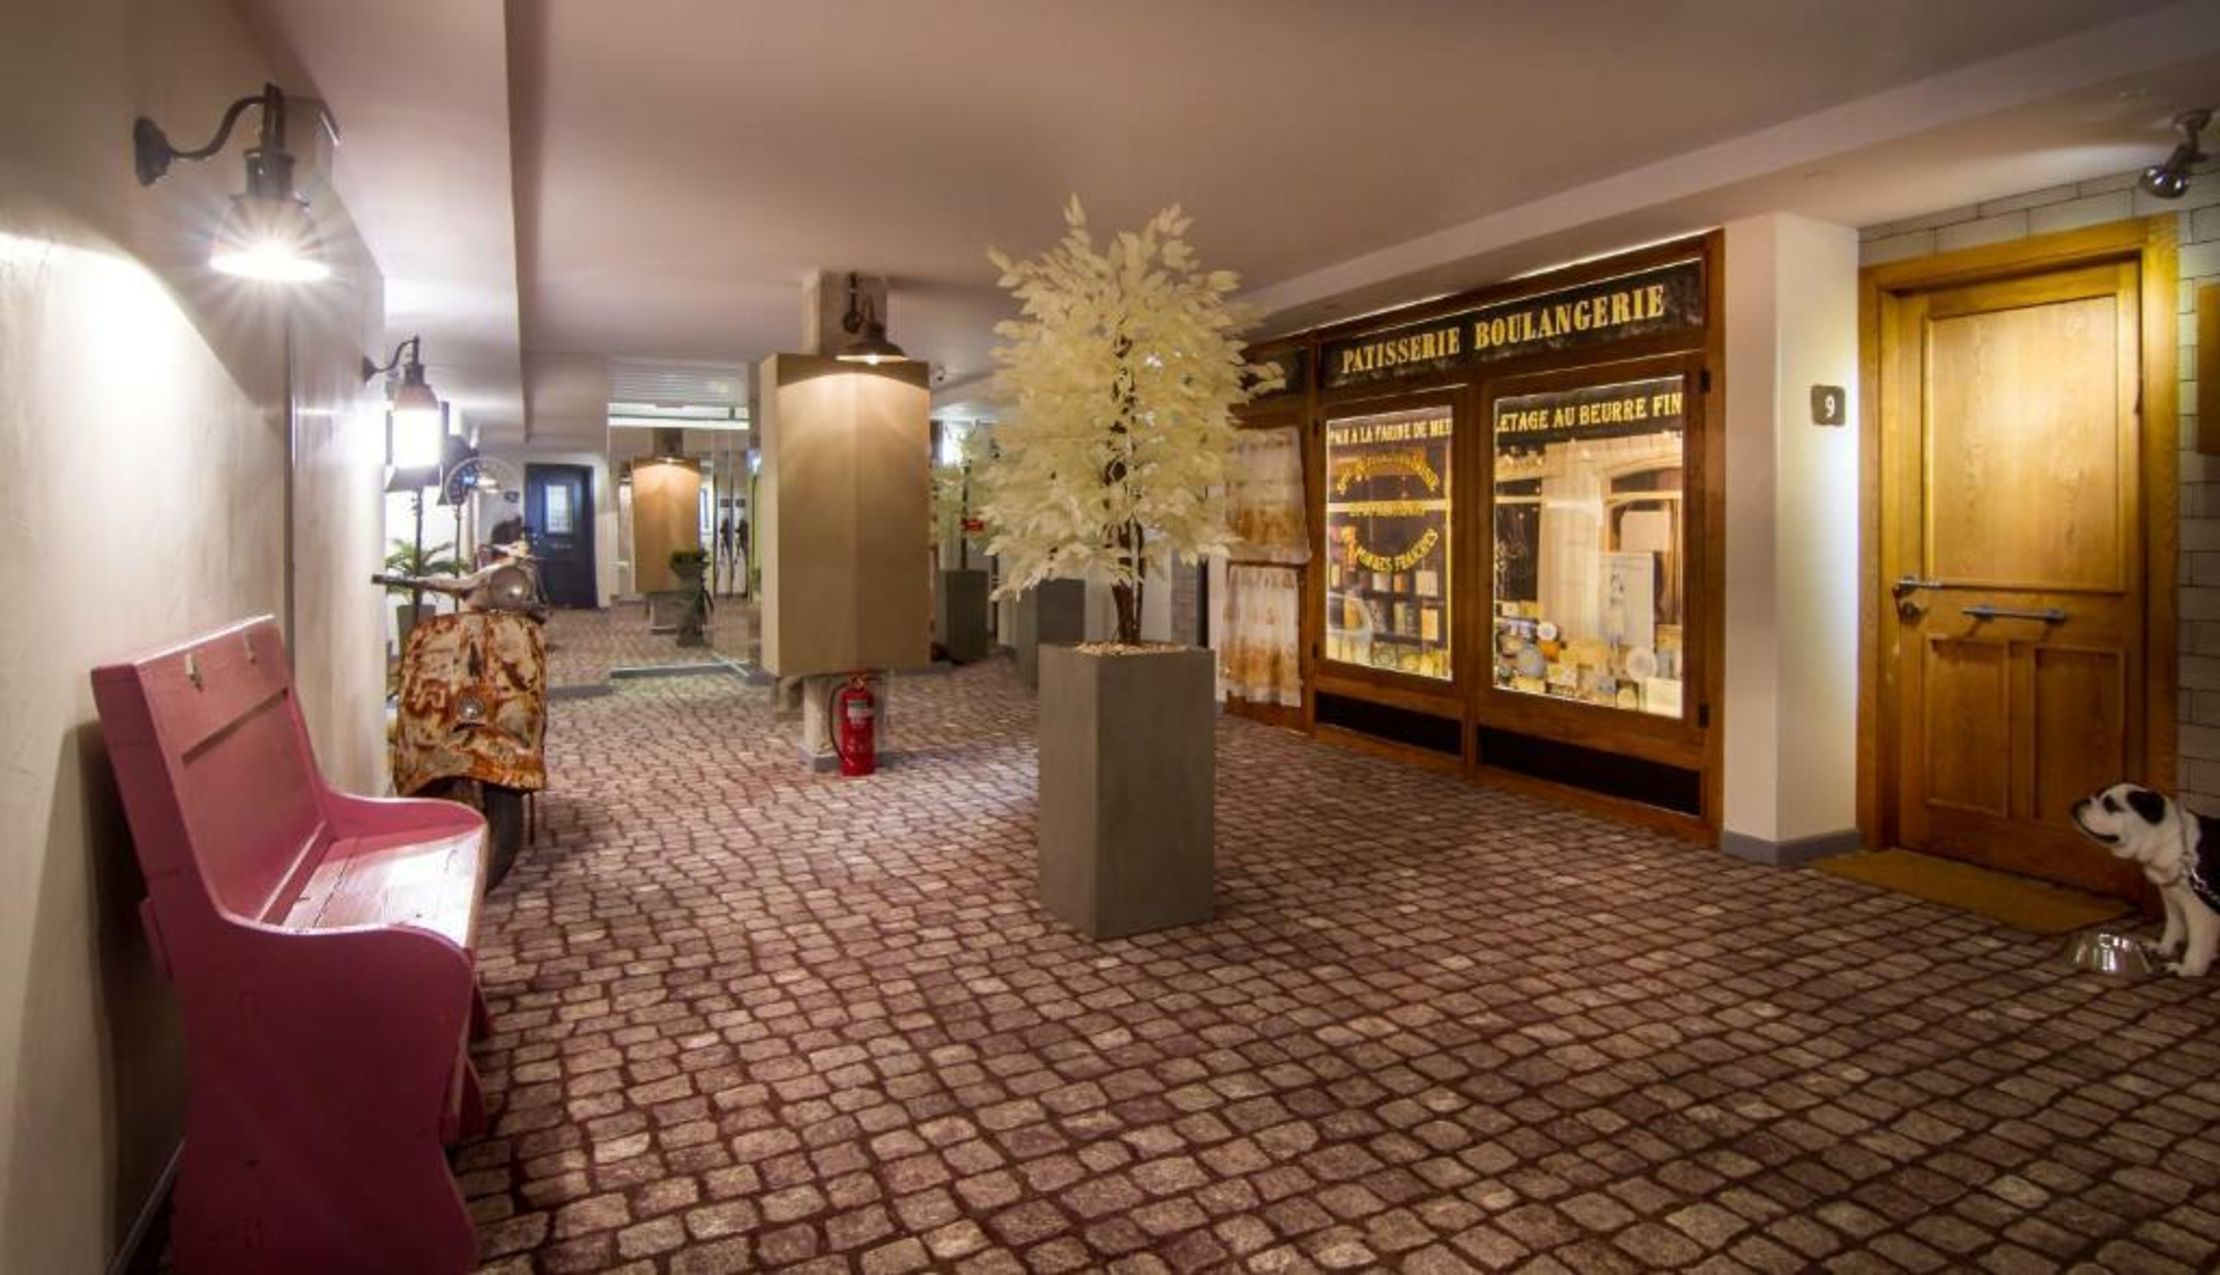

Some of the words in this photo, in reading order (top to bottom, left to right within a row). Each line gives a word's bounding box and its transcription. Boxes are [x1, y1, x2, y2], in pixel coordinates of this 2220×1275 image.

[1341, 327, 1460, 374] PATISSERIE
[1474, 285, 1664, 349] BOULANGERIE
[1553, 406, 1576, 428] AU
[1579, 397, 1648, 426] BEURRE
[1653, 391, 1683, 417] FIN
[1824, 394, 1836, 418] 9
[1413, 420, 1428, 440] DE
